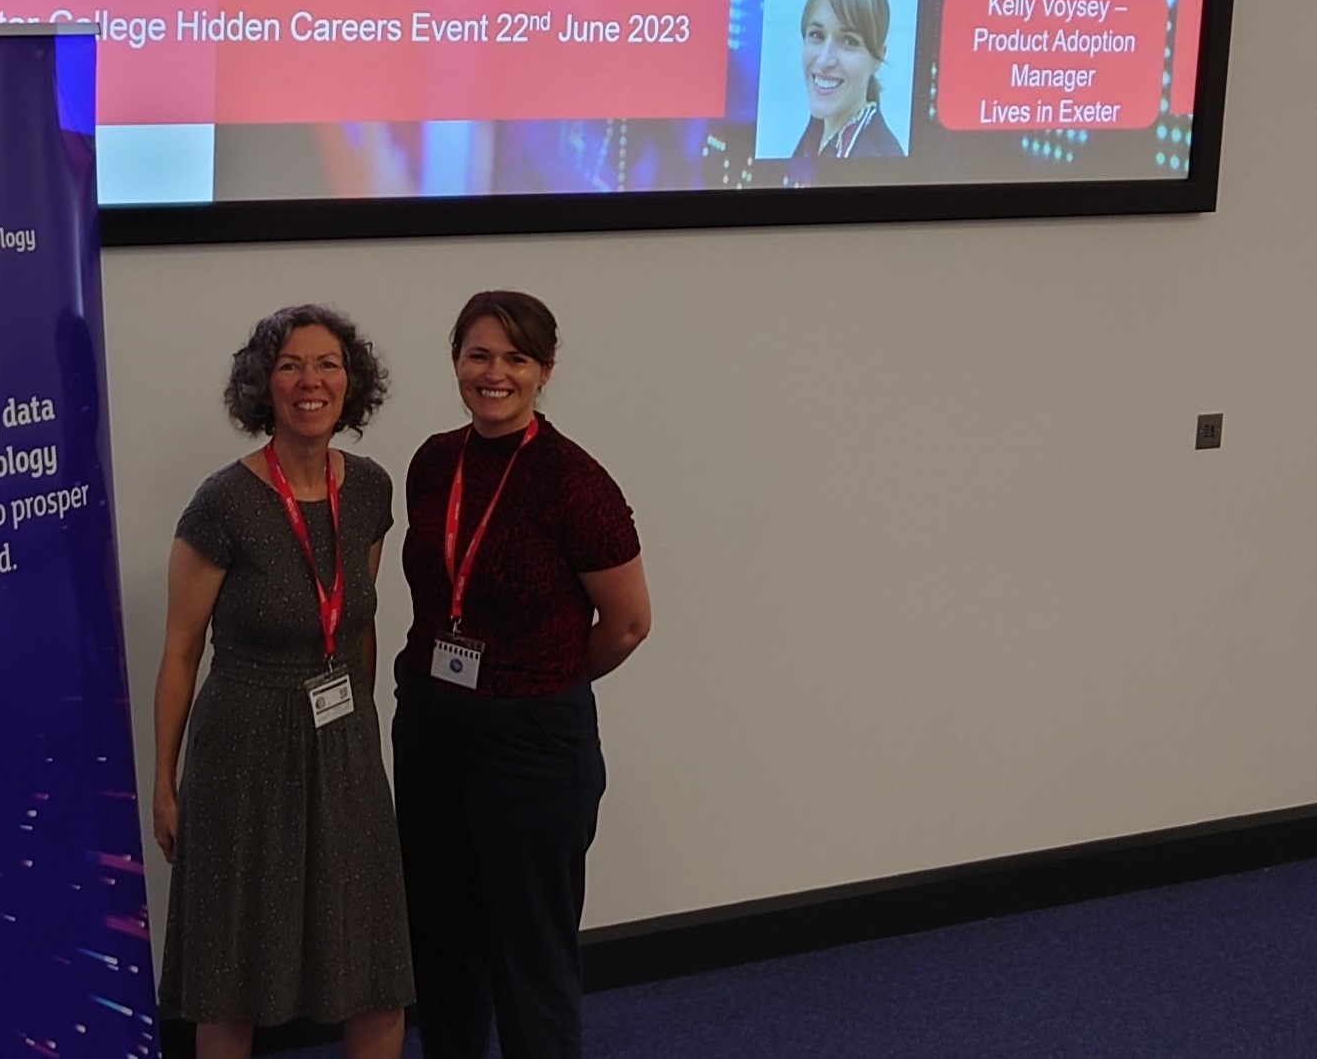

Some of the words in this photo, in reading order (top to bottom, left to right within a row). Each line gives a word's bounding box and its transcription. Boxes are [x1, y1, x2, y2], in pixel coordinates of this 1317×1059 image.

[177, 10, 280, 42] Hidden
[290, 11, 402, 42] Careers
[411, 12, 488, 42] Event
[496, 11, 551, 42] 22nd
[558, 13, 620, 42] June
[627, 14, 690, 43] 2023
[973, 28, 1049, 52] Product
[1051, 29, 1135, 58] Adoption
[1011, 64, 1096, 93] Manager
[980, 100, 1030, 123] Lives
[1036, 100, 1053, 123] in
[1059, 99, 1121, 123] Exeter
[2, 396, 55, 428] data
[11, 484, 89, 530] prosper
